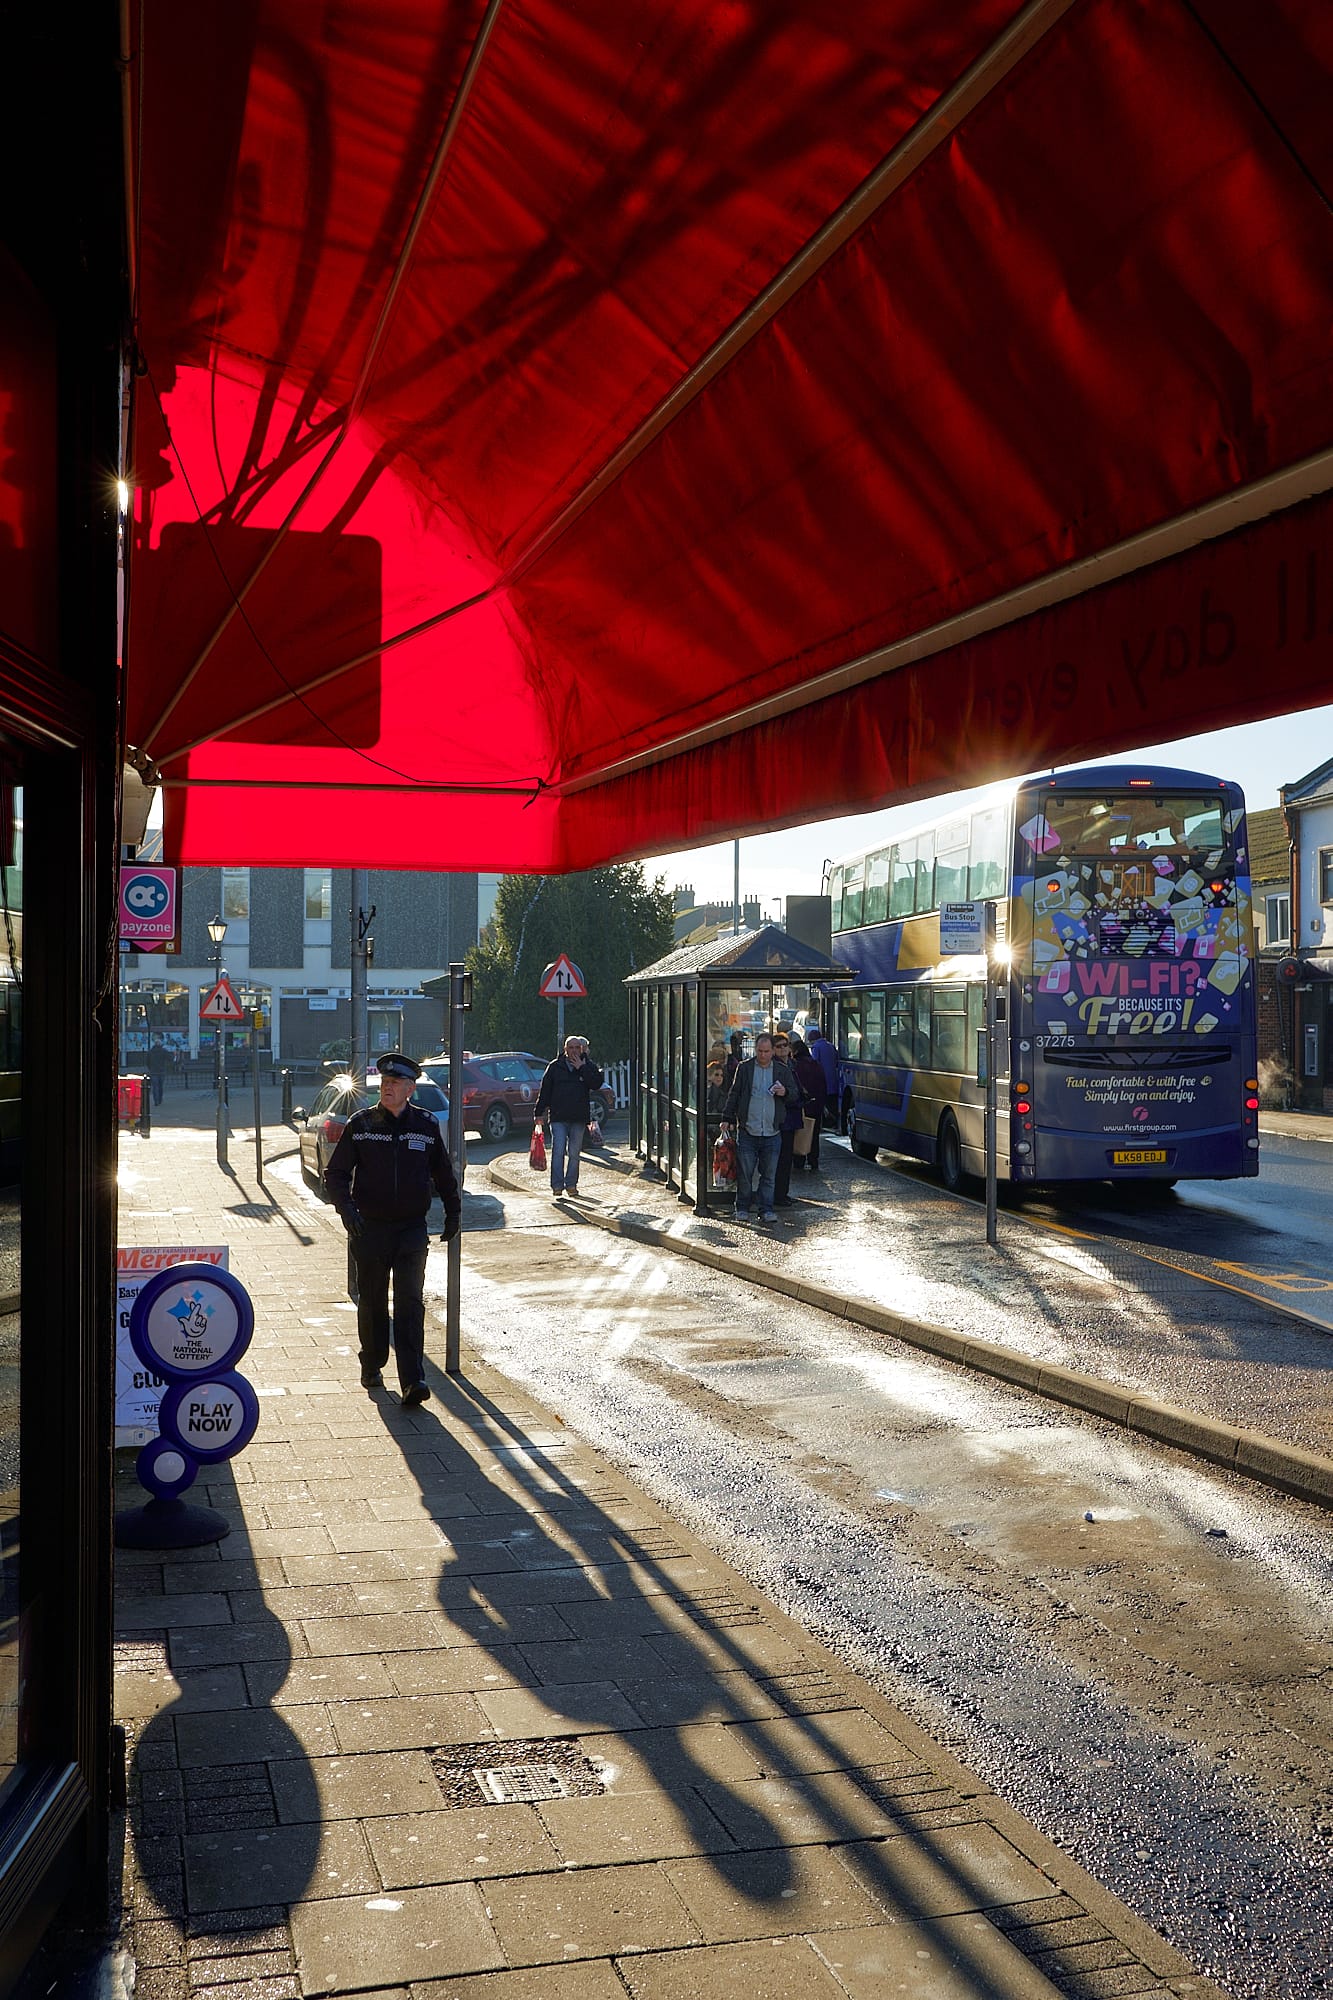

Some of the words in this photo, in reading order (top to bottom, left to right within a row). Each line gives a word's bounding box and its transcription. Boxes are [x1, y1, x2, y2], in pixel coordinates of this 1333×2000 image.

[121, 923, 171, 934] payzone
[1075, 960, 1202, 996] WI-FI?
[1118, 998, 1164, 1011] BECAUSE
[1164, 998, 1183, 1011] IT'S
[1078, 996, 1195, 1035] Free!
[1035, 1035, 1076, 1048] 37275
[1065, 1076, 1089, 1089] Fast,
[1090, 1076, 1146, 1091] comfortable
[1146, 1076, 1156, 1087] &
[1156, 1076, 1177, 1087] with
[1177, 1075, 1196, 1090] free
[1084, 1090, 1119, 1104] Simply
[1119, 1090, 1135, 1104] log
[1136, 1092, 1148, 1101] on
[1149, 1090, 1169, 1101] and
[1169, 1090, 1196, 1104] enjoy.
[1103, 1124, 1177, 1133] www.firstgroup.com
[1117, 1152, 1142, 1162] LK58
[1144, 1152, 1163, 1162] EDJ
[117, 1249, 223, 1269] Mercury
[119, 1287, 141, 1298] East
[189, 1403, 234, 1418] PLAY
[188, 1417, 233, 1432] NOW
